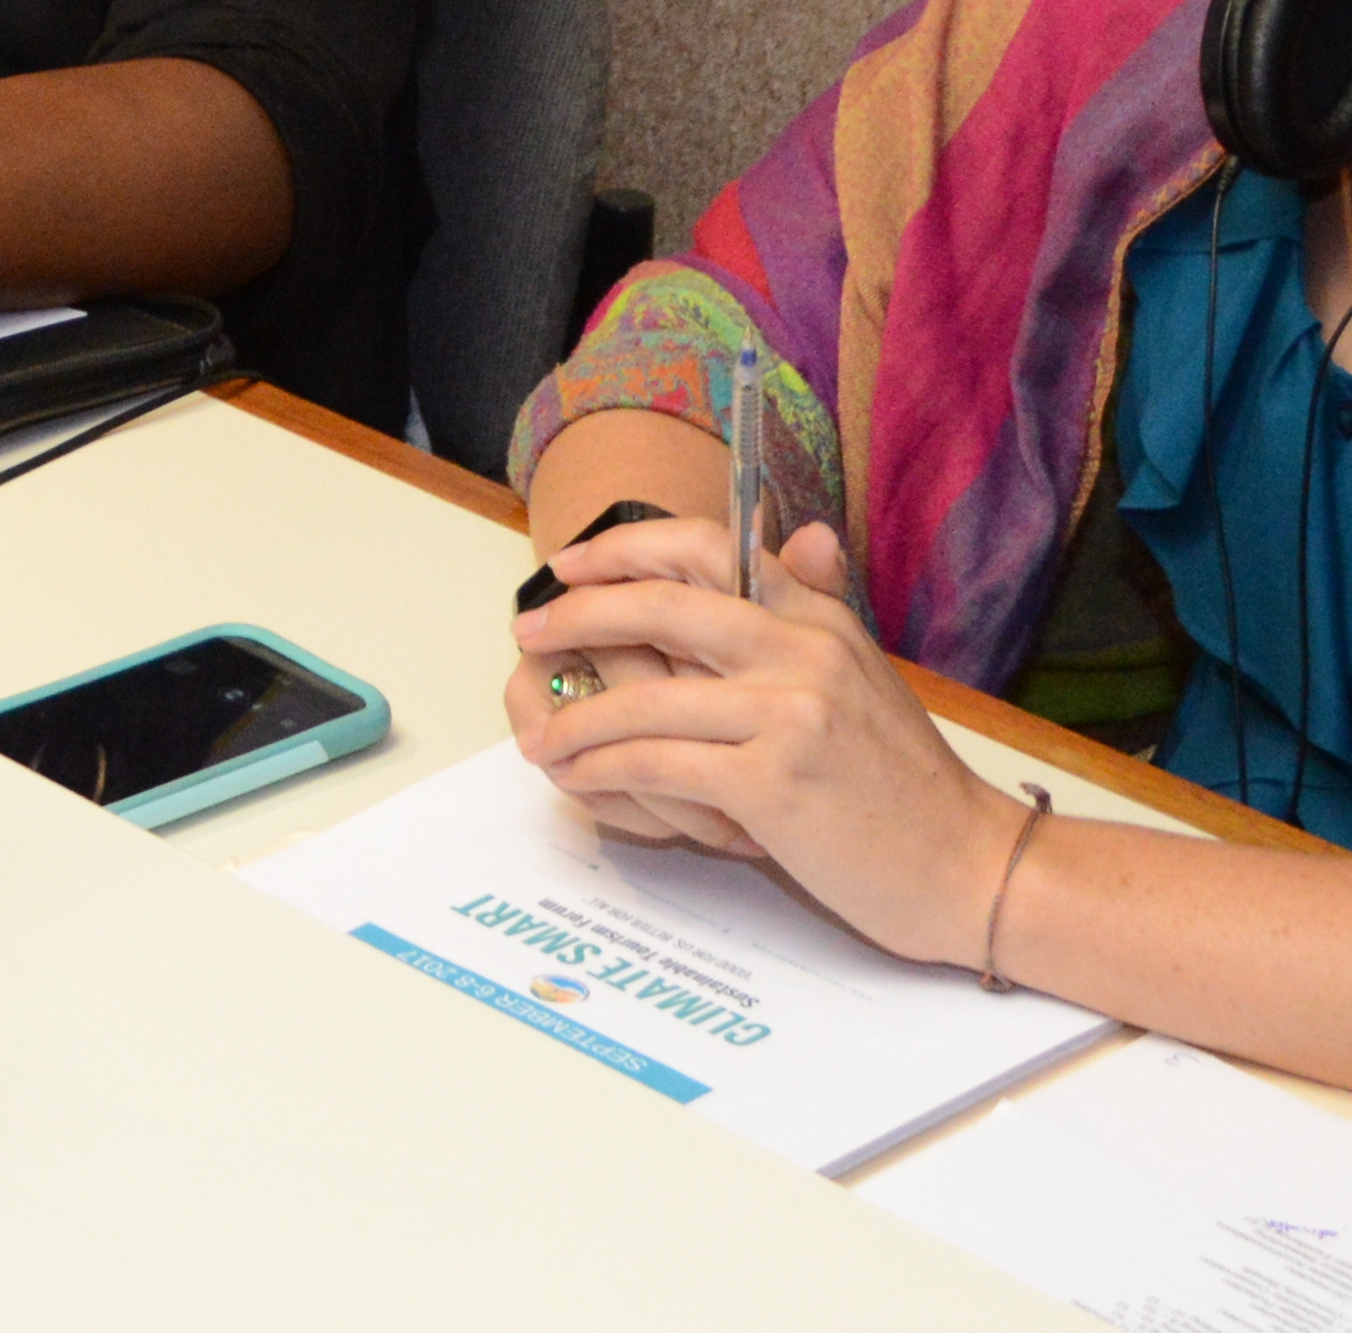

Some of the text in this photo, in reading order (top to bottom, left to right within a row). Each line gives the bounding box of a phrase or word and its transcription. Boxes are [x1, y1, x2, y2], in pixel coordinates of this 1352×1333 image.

[451, 893, 602, 967] SMART
[538, 898, 593, 930] Forum
[592, 922, 658, 962] Tourism
[585, 956, 772, 1047] CLIMATE
[659, 956, 761, 1009] Sustainable
[497, 995, 647, 1073] SEPTEMBER
